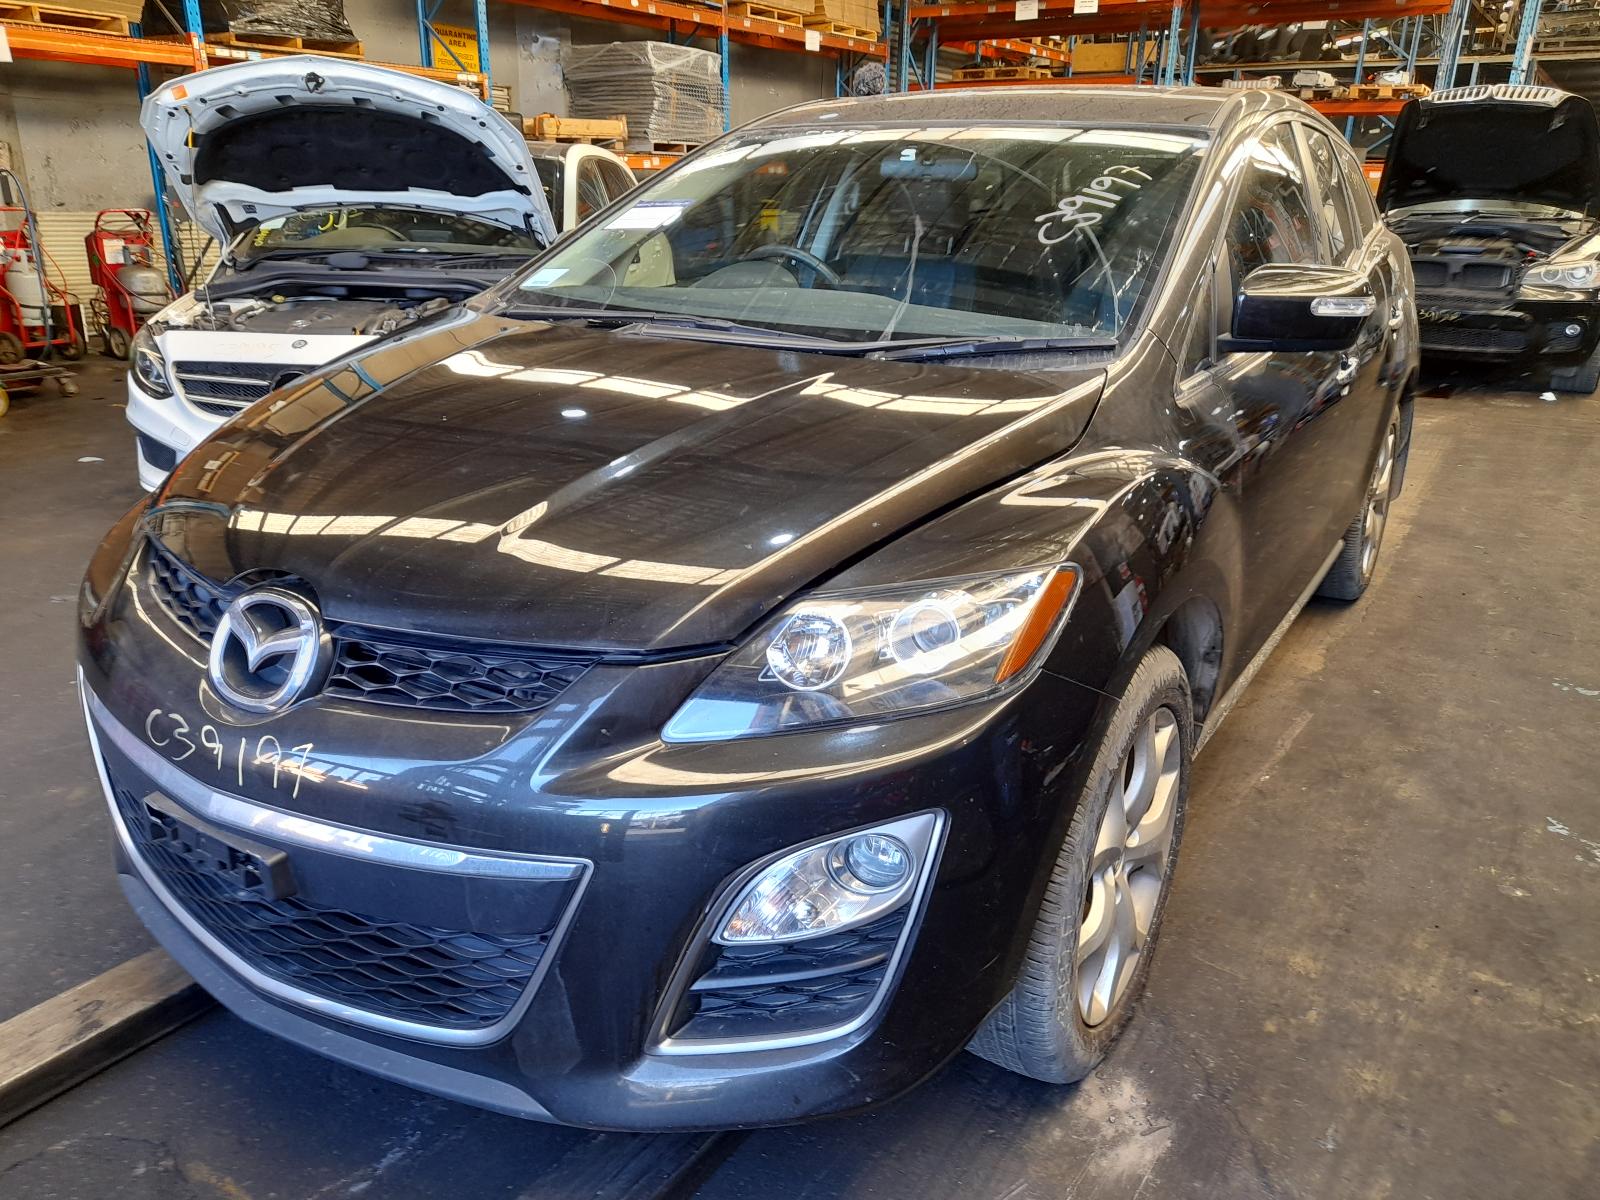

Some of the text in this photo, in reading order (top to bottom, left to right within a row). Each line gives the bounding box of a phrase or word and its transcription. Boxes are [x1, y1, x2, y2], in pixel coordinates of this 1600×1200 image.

[434, 28, 477, 41] QUARANTINE
[448, 39, 467, 48] AREA
[1034, 165, 1153, 245] C39197
[145, 708, 314, 800] C39197
